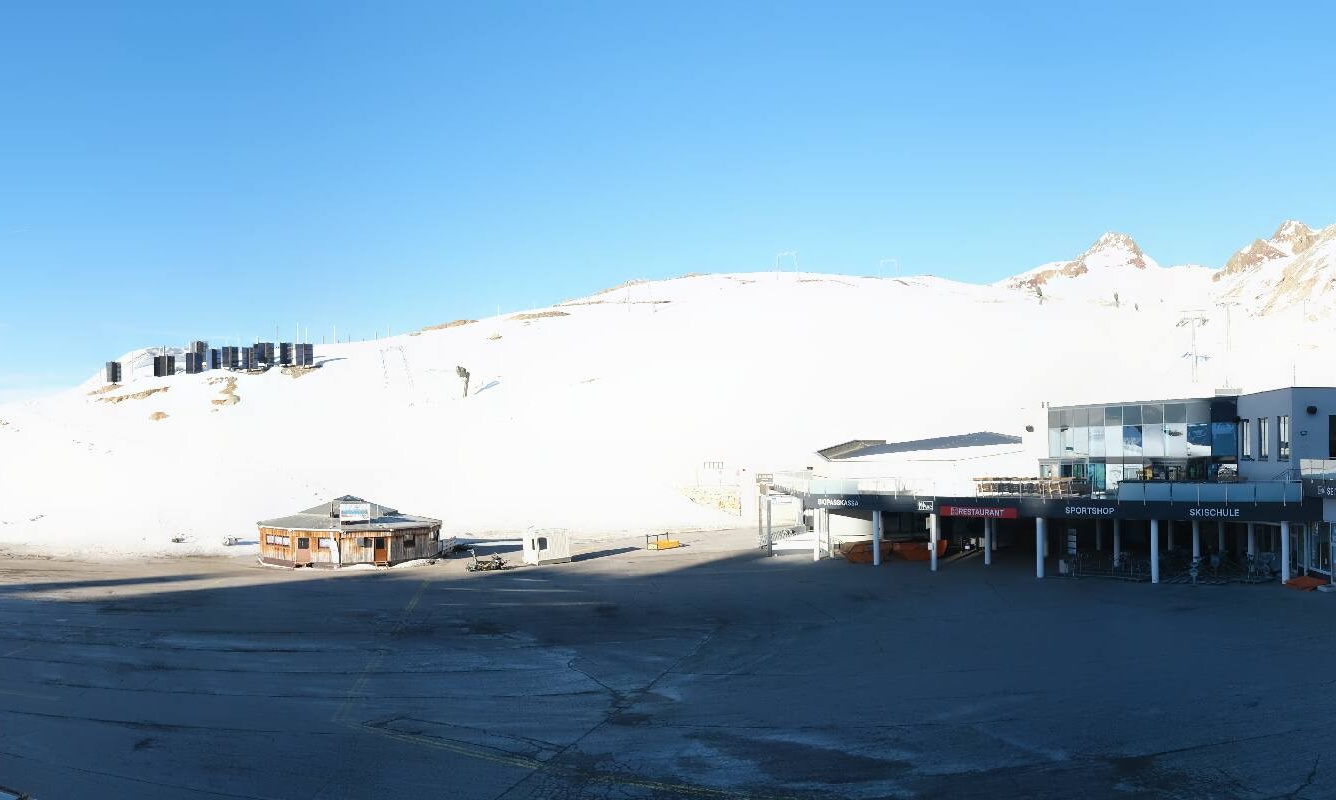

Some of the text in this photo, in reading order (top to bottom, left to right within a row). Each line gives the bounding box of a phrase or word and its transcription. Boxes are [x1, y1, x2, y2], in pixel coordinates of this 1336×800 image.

[958, 508, 1005, 517] RESTAURANT
[1065, 506, 1115, 515] SPORTSHOP
[1189, 508, 1240, 517] SKISCHULE
